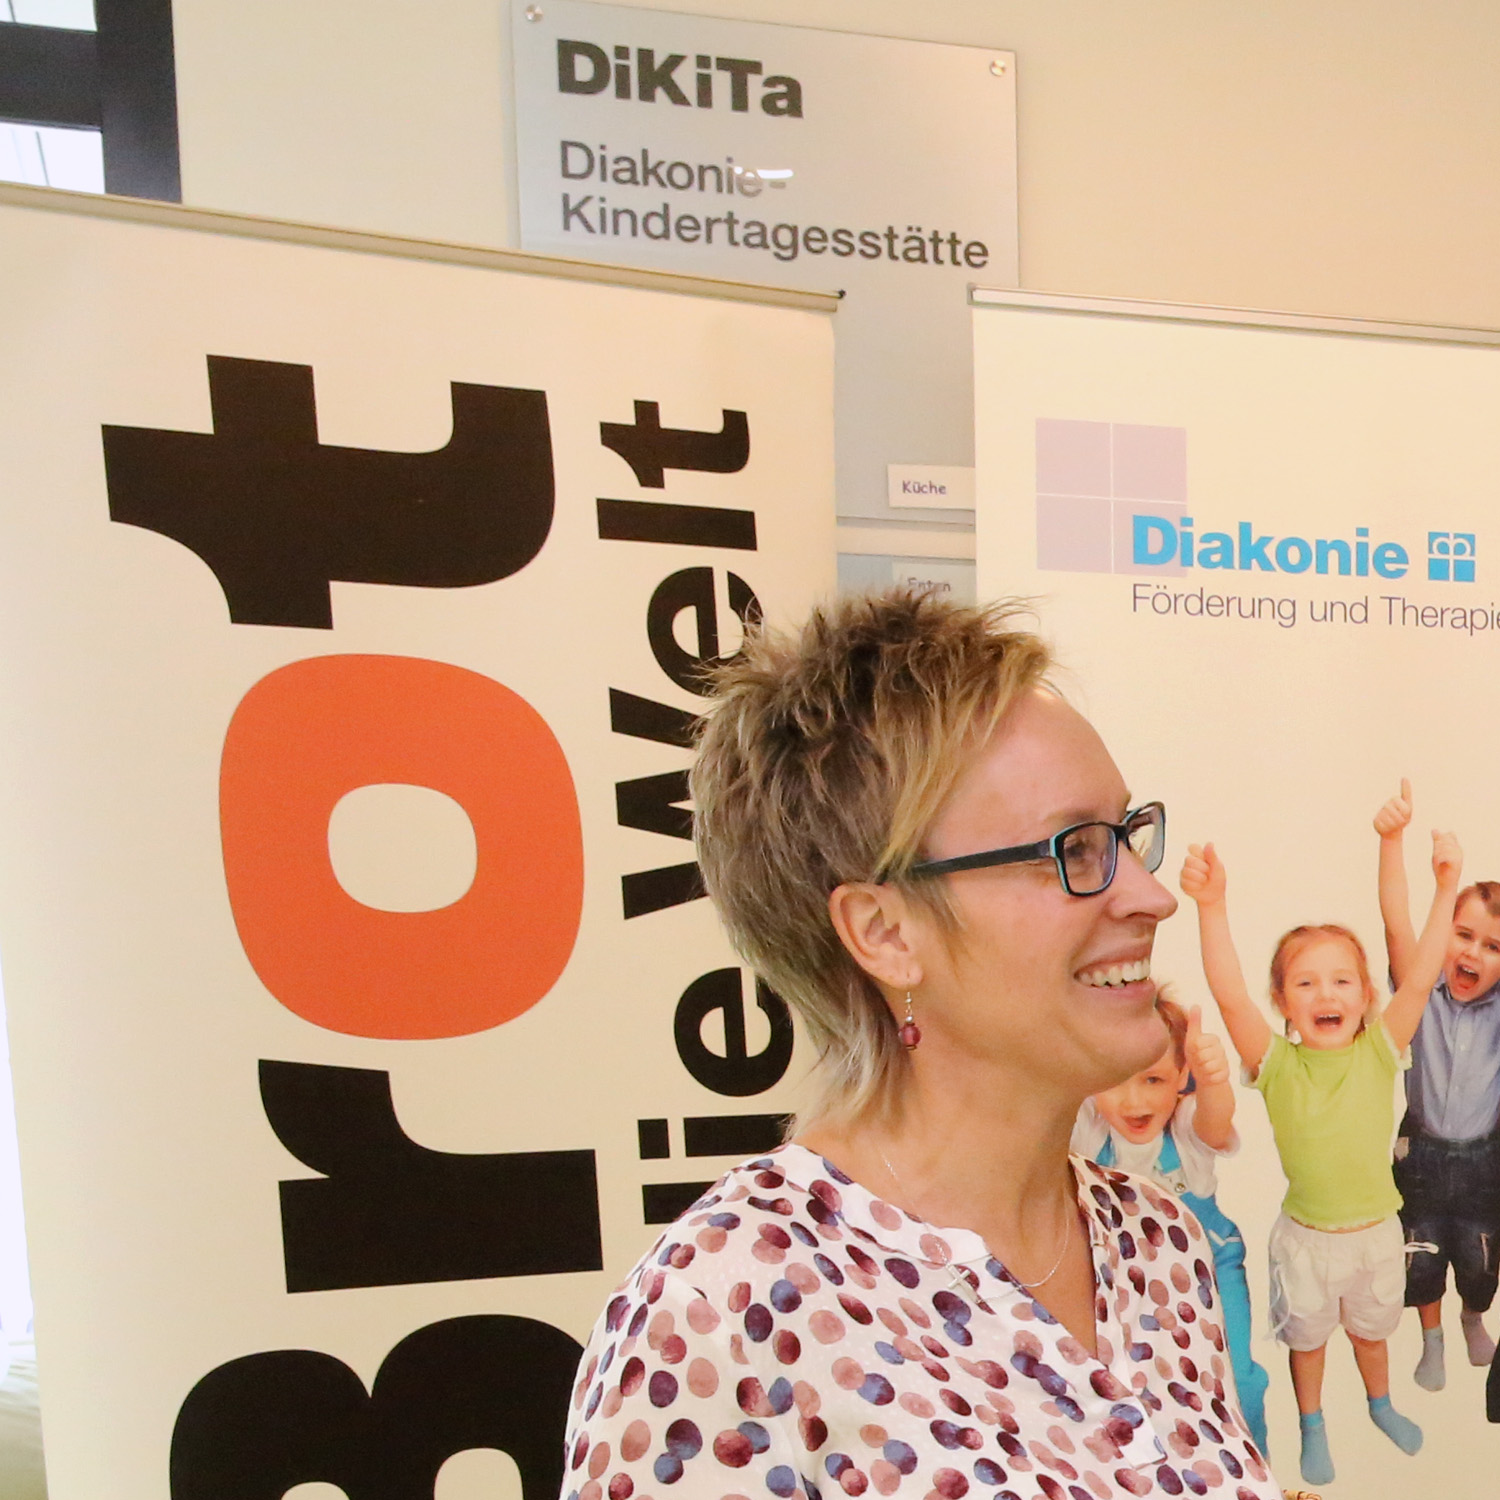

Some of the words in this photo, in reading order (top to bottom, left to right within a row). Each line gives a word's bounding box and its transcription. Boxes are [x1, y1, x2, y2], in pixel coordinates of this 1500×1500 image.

[557, 39, 803, 118] DiKiTa
[560, 140, 787, 200] Diakonie-
[560, 194, 989, 269] Kindertagesstätte
[902, 480, 947, 495] Küche
[1132, 515, 1409, 579] Diakonie
[907, 577, 951, 592] Entn
[1132, 583, 1297, 628] Förderung
[1310, 594, 1369, 624] und
